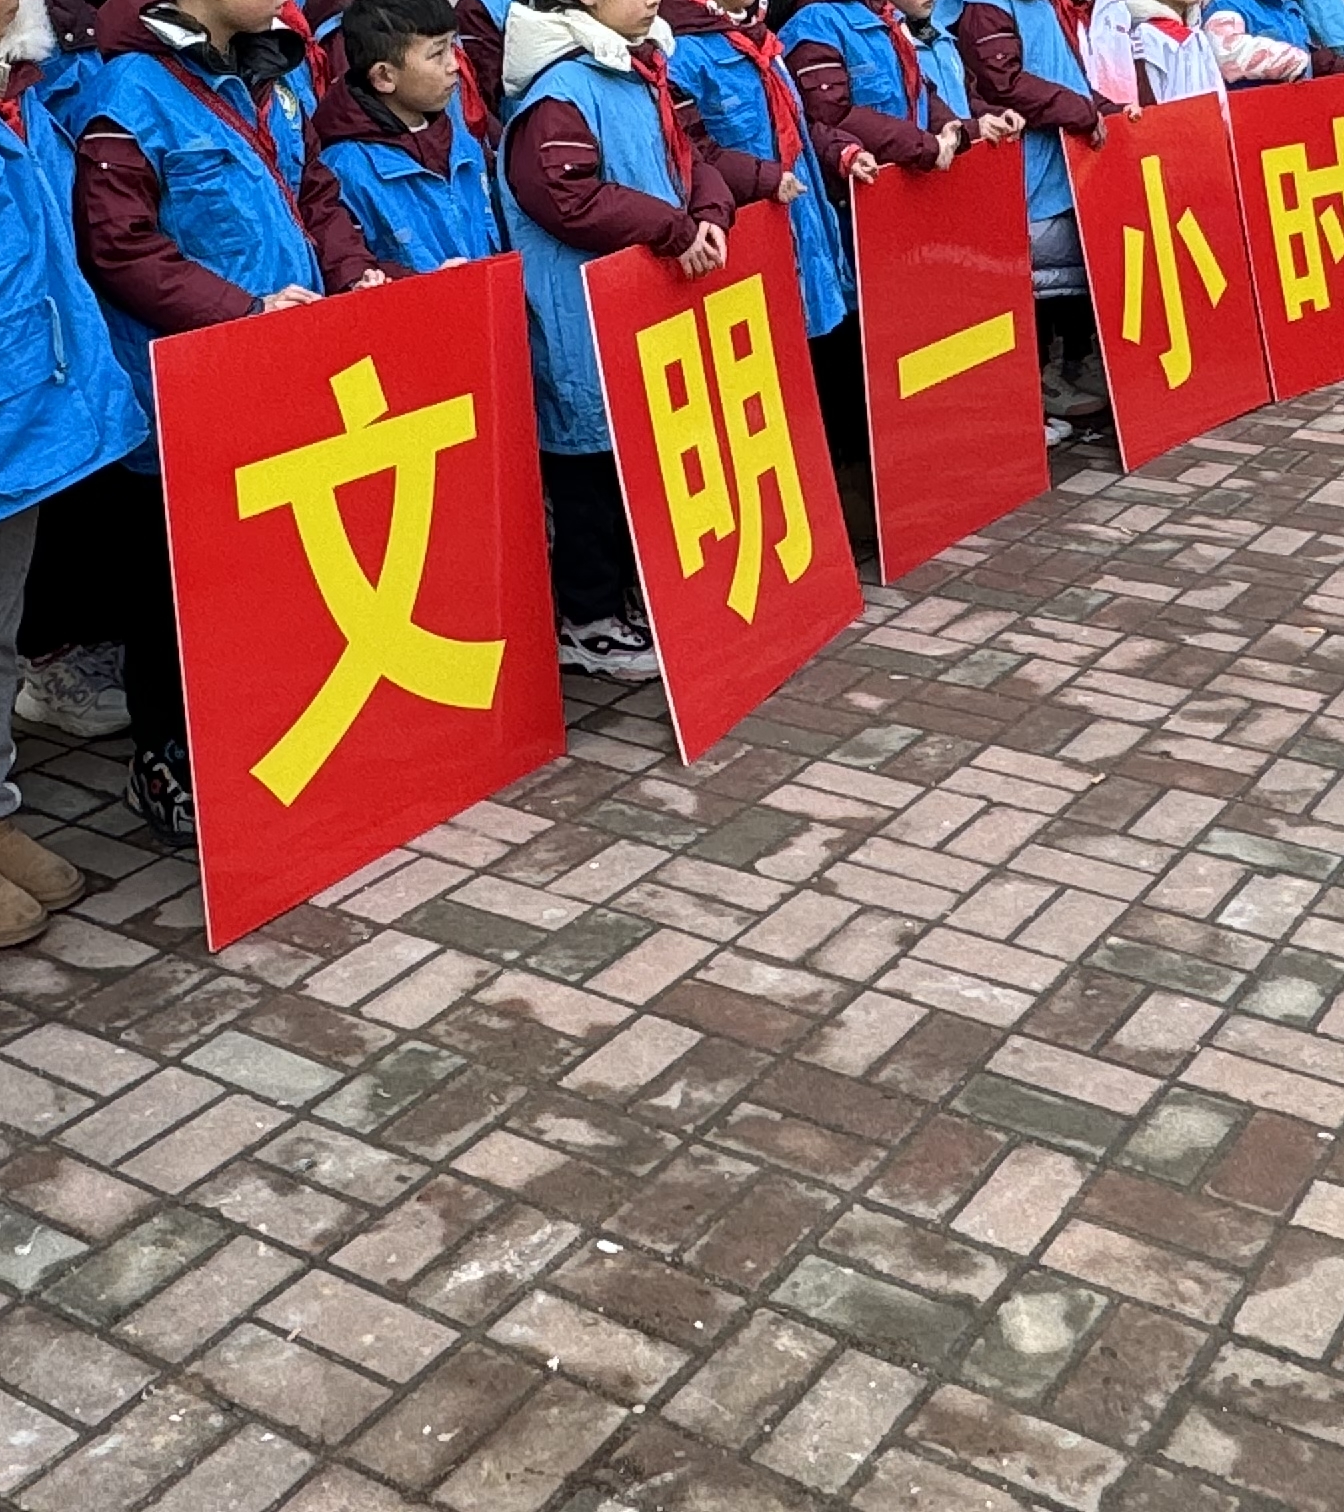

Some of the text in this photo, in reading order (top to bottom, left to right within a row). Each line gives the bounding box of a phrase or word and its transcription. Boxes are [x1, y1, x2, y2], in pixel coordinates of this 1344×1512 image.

[897, 310, 1016, 400] 一
[1122, 154, 1228, 389] 小
[235, 355, 507, 807] 文
[636, 273, 813, 625] 明
